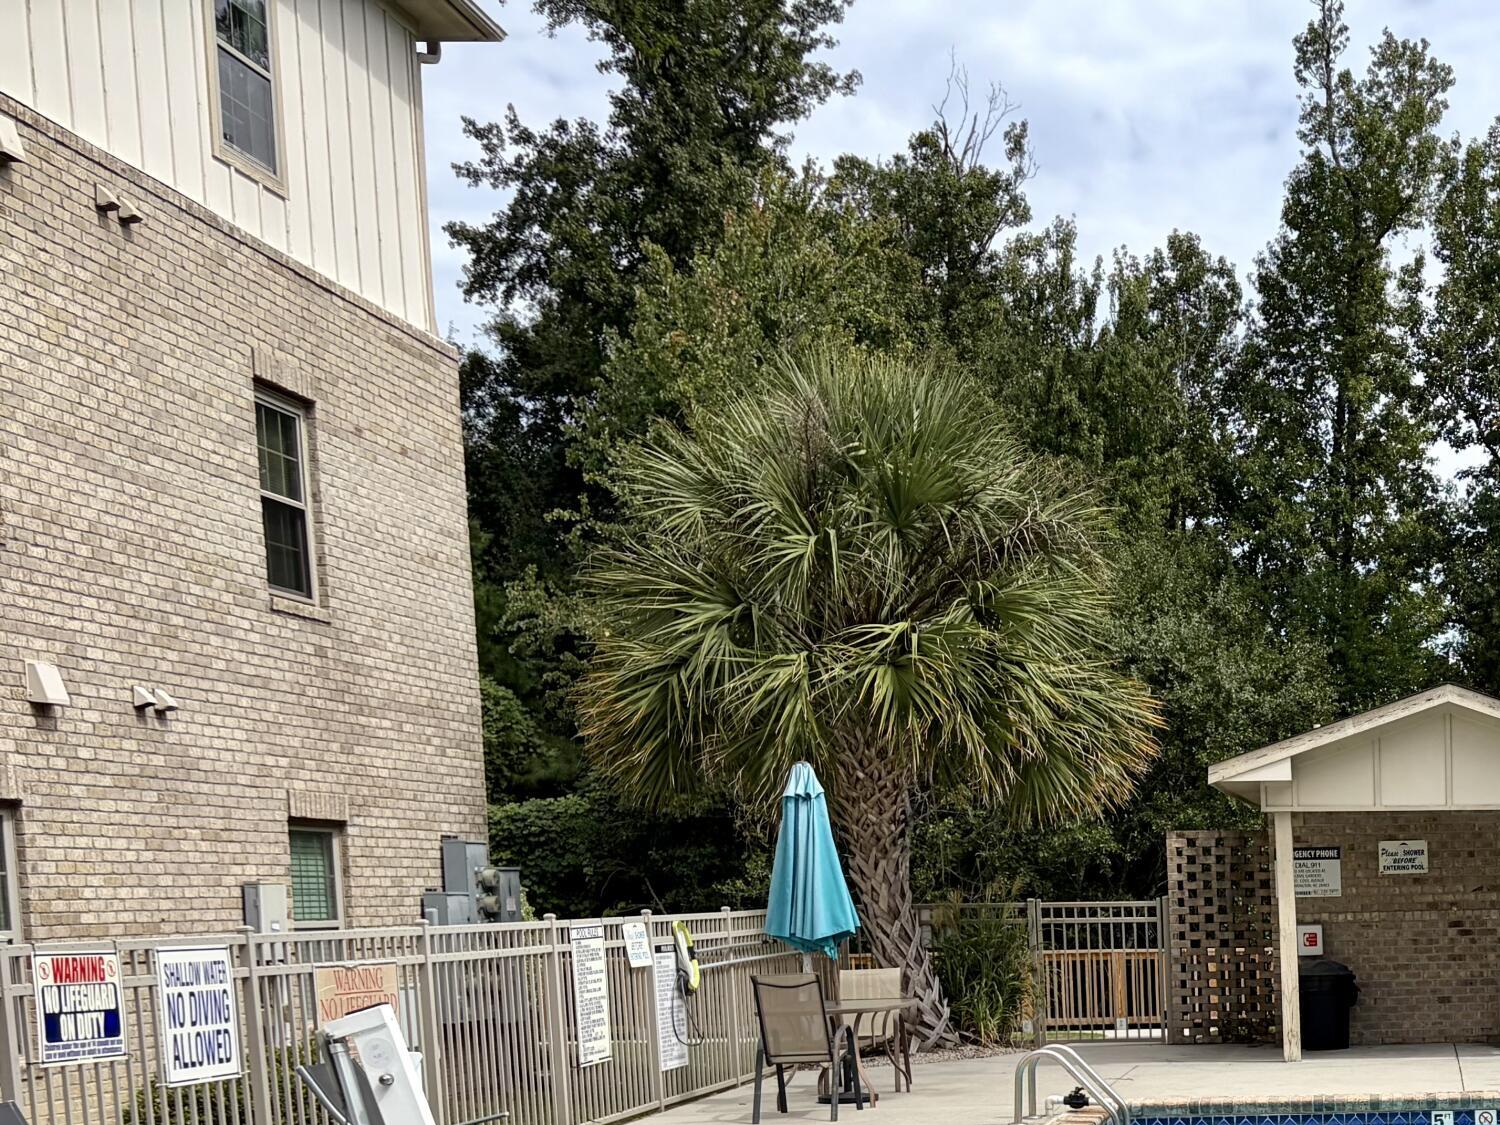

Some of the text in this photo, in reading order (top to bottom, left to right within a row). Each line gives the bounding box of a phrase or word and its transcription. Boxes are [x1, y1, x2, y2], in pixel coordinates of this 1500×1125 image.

[1316, 849, 1339, 858] PHONE
[51, 956, 106, 984] WARNING
[163, 960, 228, 988] SHALLOW WATER
[333, 967, 384, 992] WARNING
[43, 983, 117, 1014] NO LIFEGUARD
[167, 988, 231, 1029] NO DIVING
[320, 998, 338, 1021] NO
[60, 1011, 105, 1042] ON DUTY
[173, 1028, 232, 1070] ALLOWED
